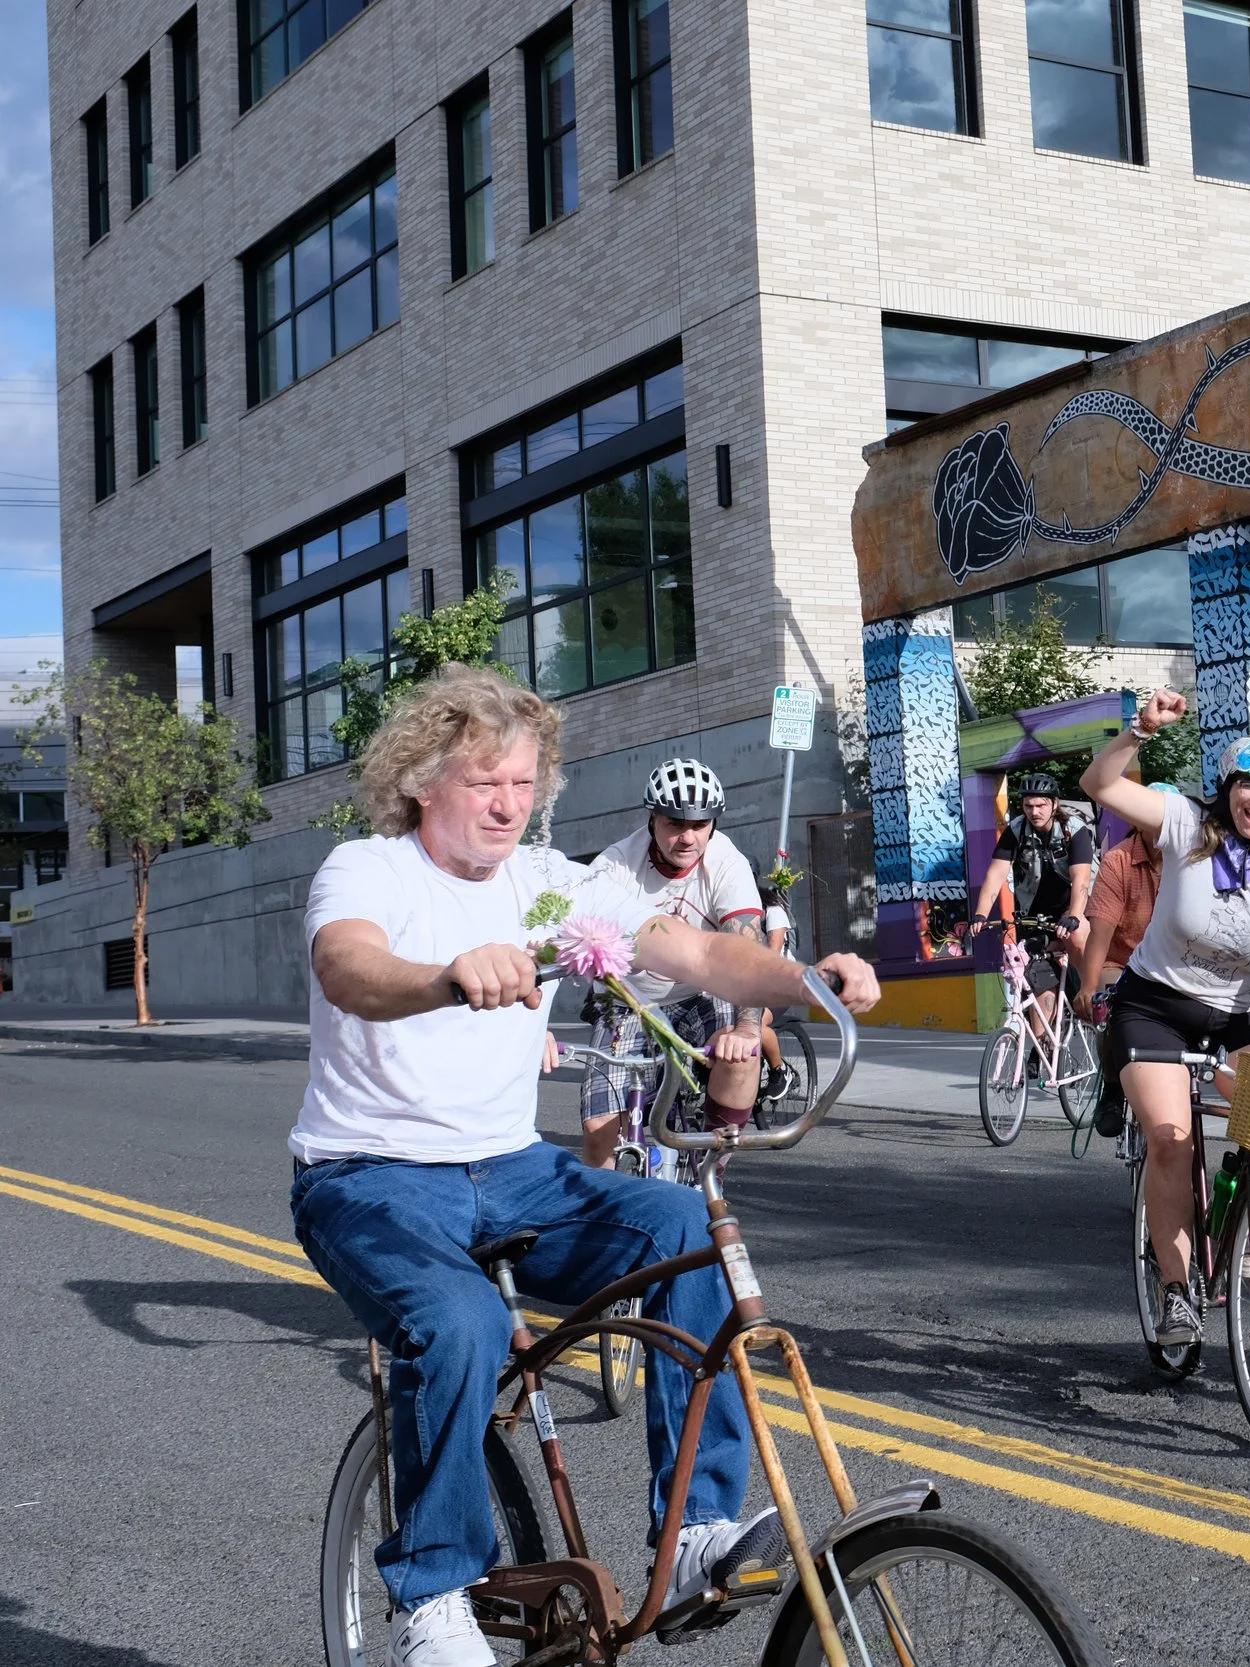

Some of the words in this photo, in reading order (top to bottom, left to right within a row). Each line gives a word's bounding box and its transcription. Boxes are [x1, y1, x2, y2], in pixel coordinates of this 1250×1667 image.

[780, 689, 787, 698] 2
[779, 700, 810, 708] VISITOR
[776, 706, 811, 715] PARKING
